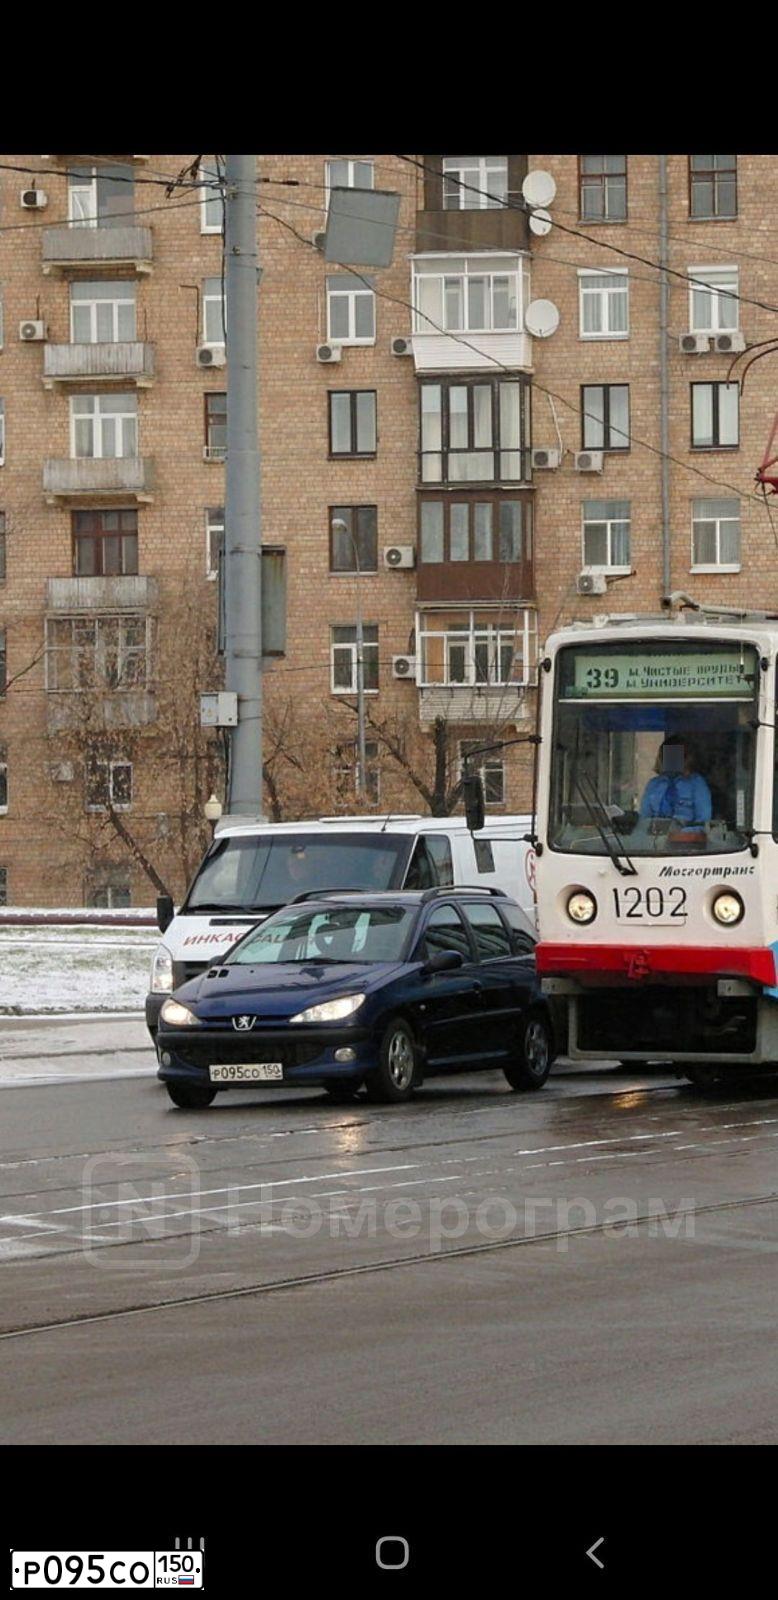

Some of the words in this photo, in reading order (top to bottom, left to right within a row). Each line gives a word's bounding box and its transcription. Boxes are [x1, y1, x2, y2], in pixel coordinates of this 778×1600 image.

[586, 668, 619, 688] 39
[612, 886, 688, 918] 1202
[262, 1064, 281, 1075] 150
